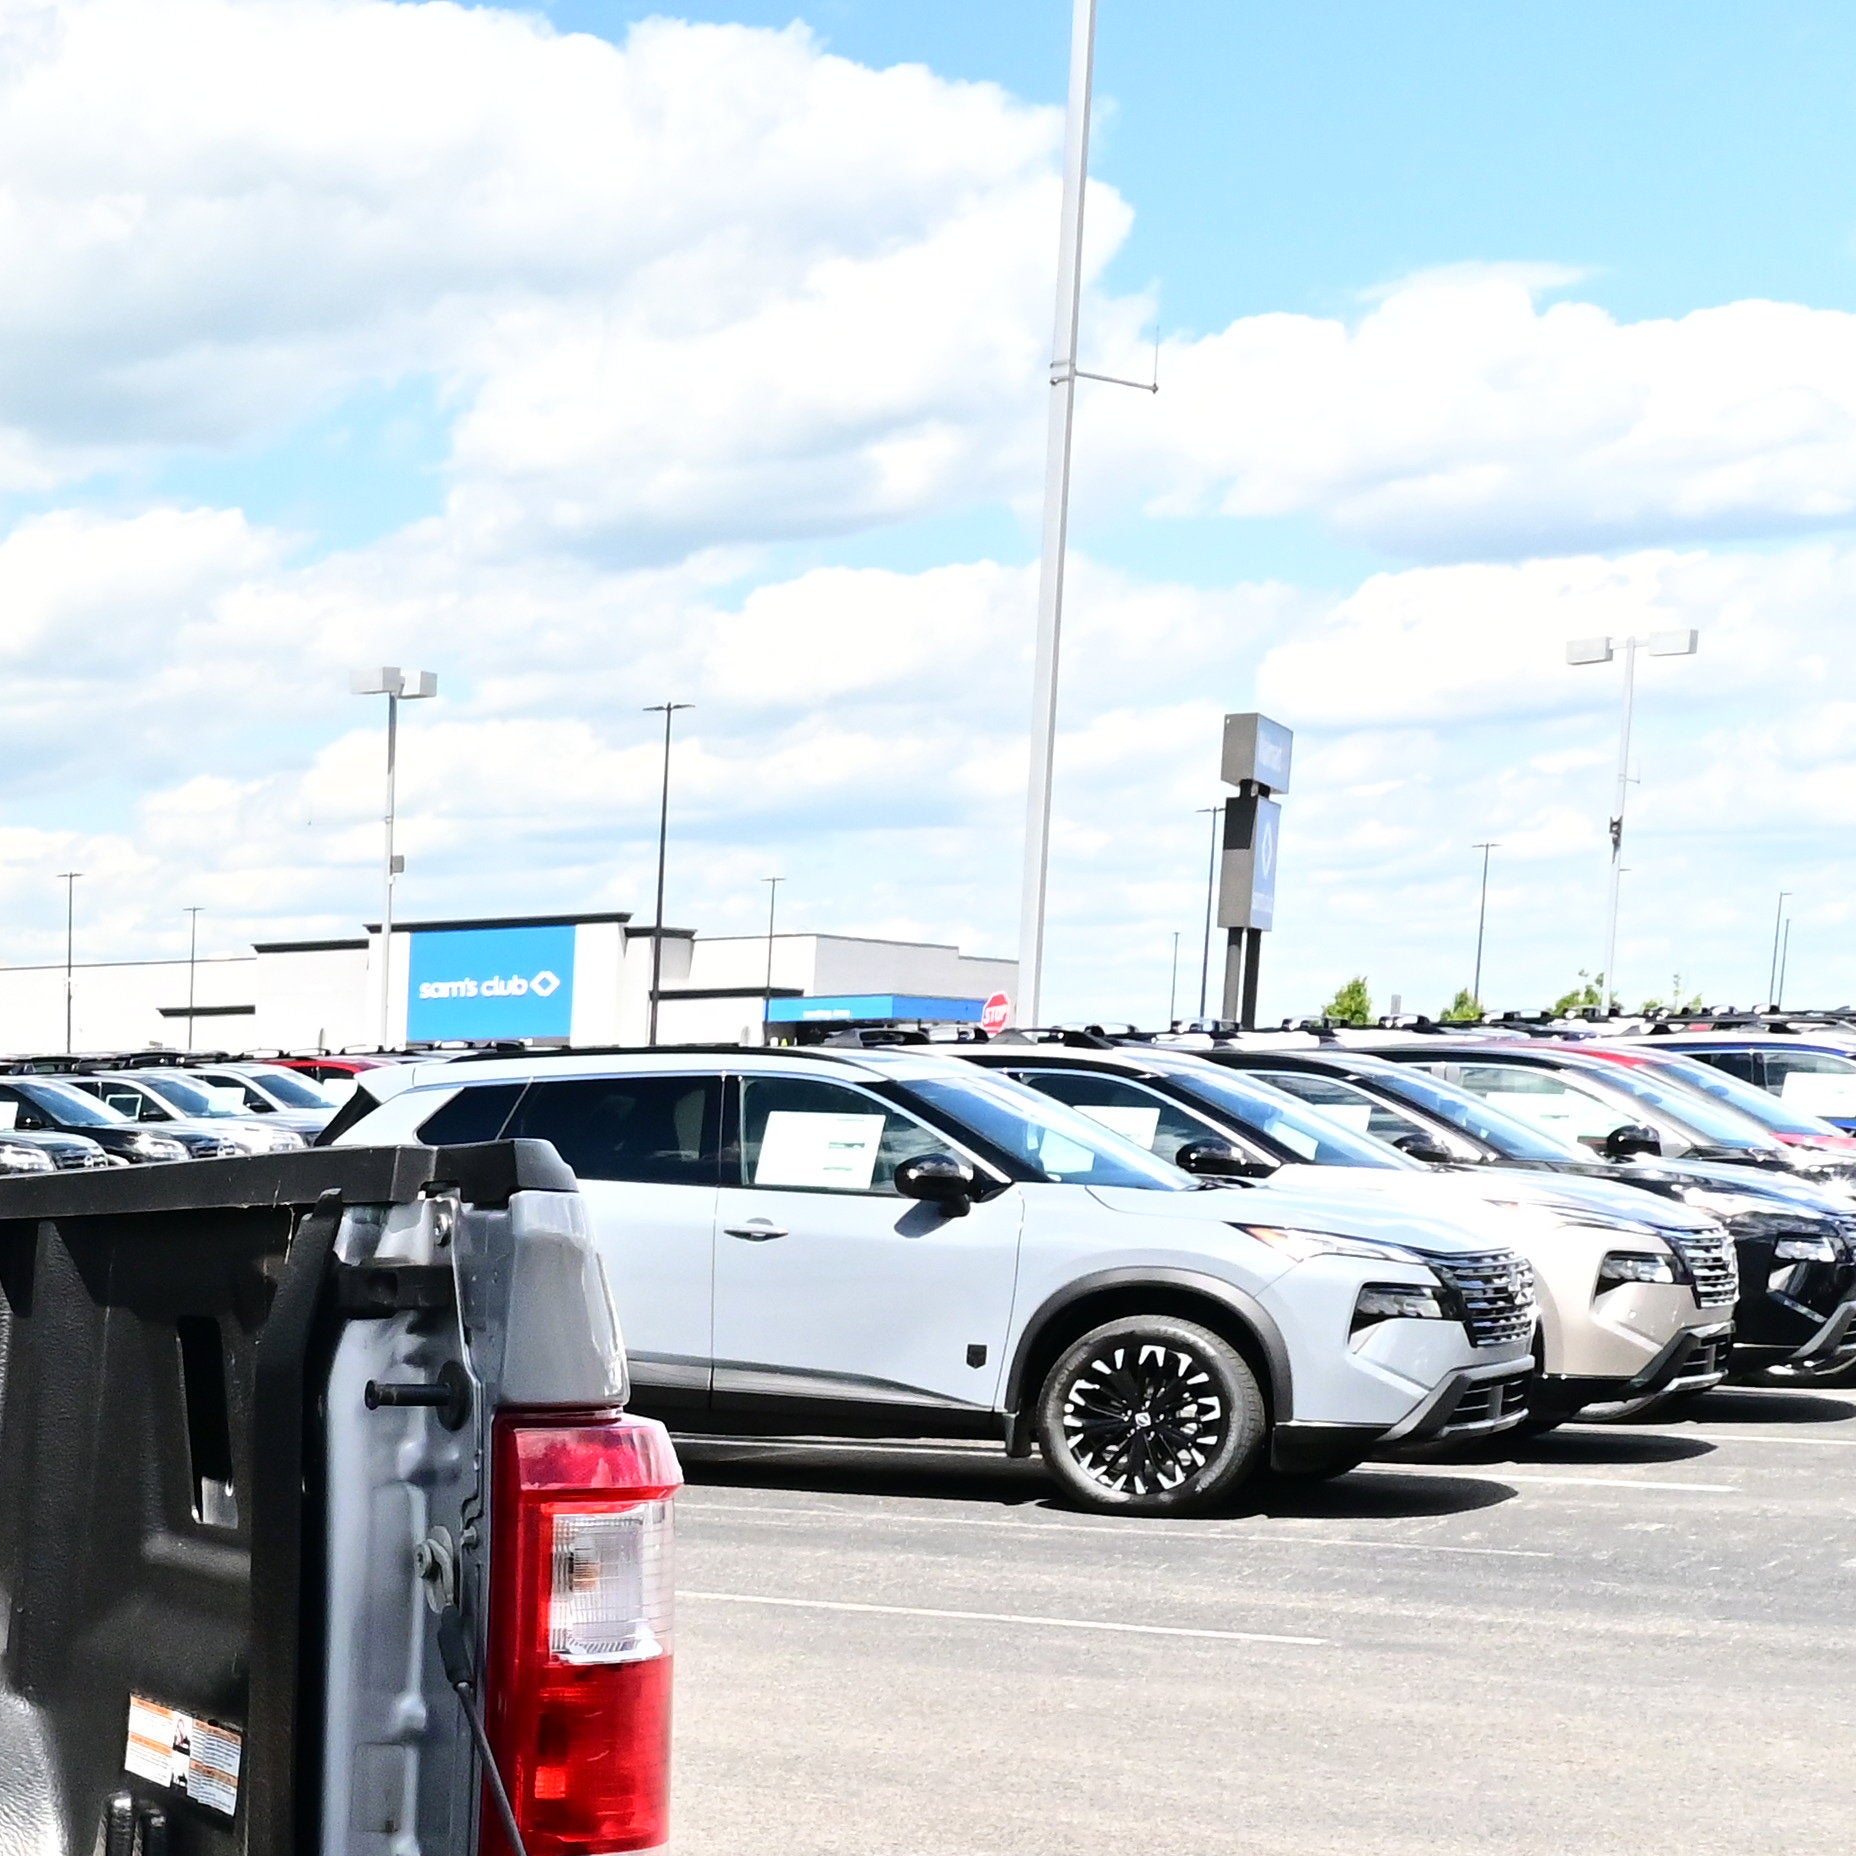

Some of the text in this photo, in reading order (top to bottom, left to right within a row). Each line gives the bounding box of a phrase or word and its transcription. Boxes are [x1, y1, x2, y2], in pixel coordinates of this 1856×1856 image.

[420, 975, 529, 999] sam's club
[983, 1005, 1008, 1024] STOP
